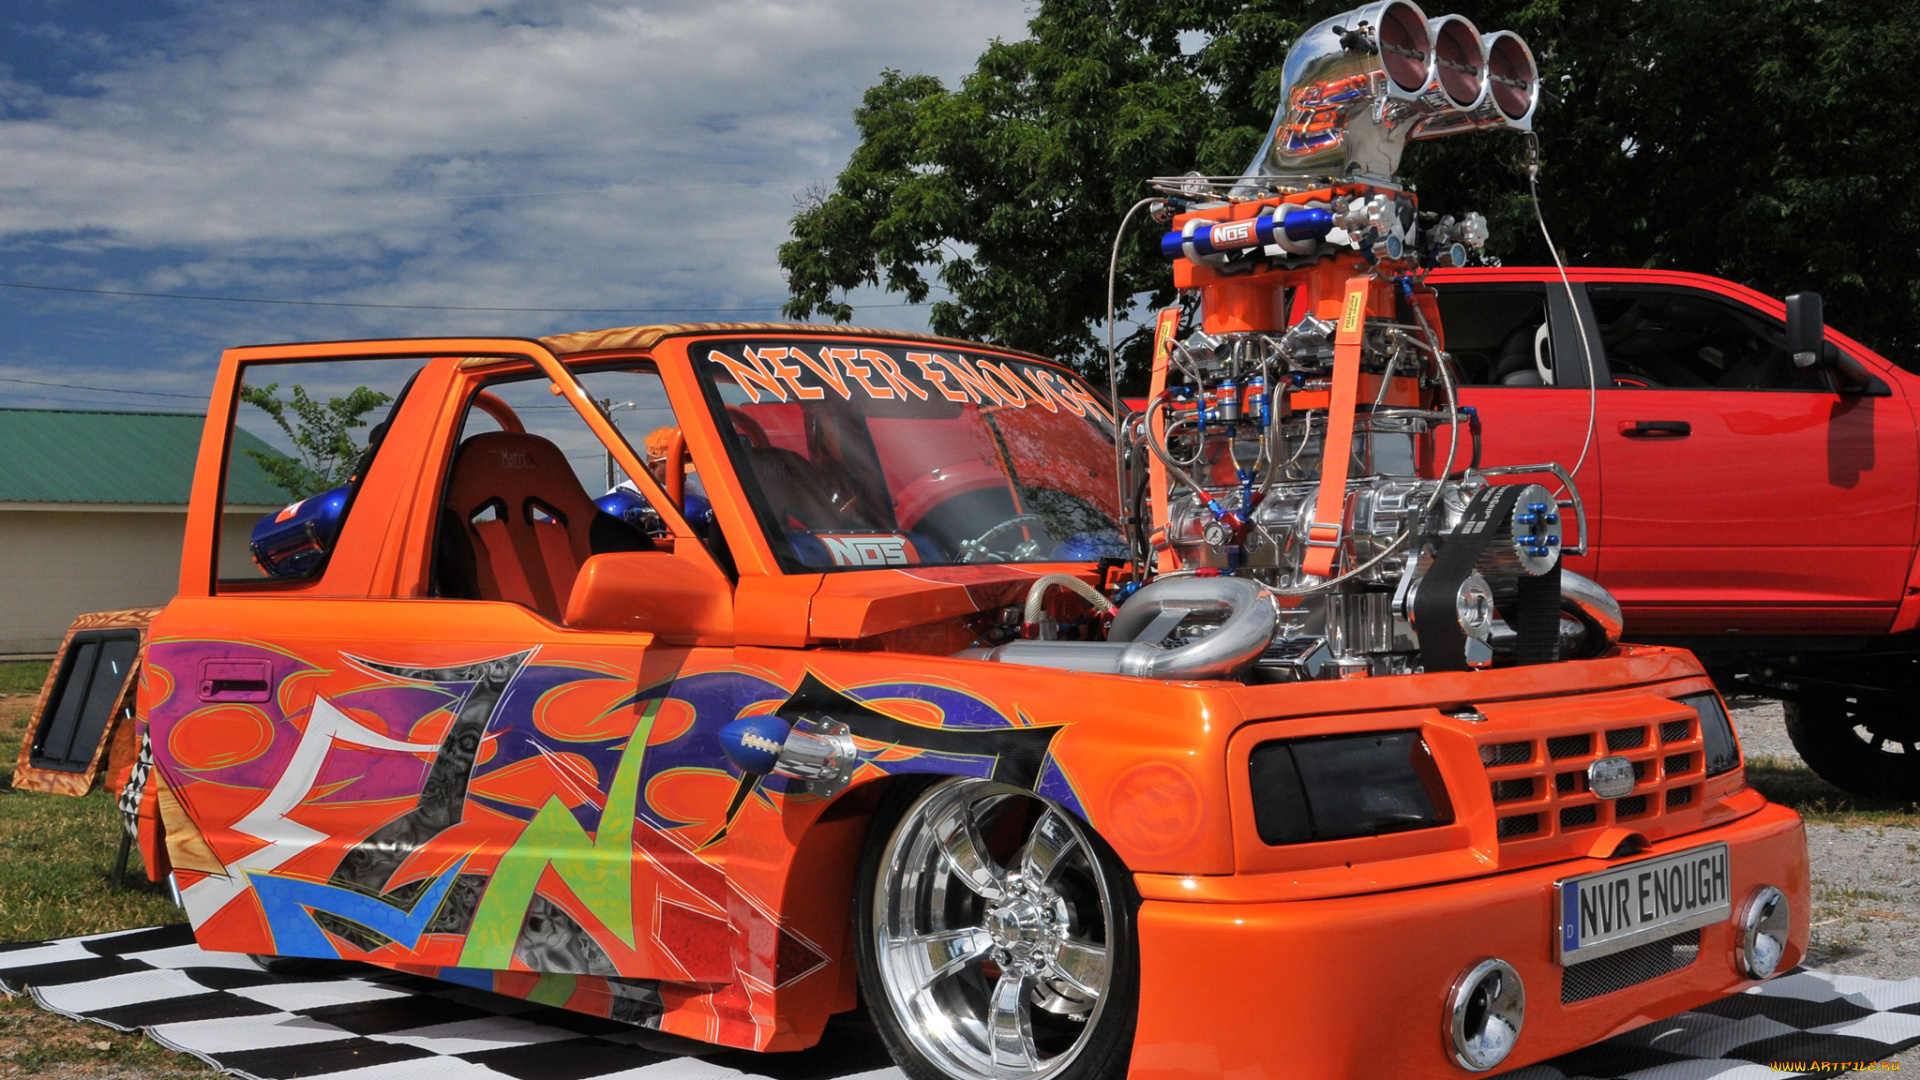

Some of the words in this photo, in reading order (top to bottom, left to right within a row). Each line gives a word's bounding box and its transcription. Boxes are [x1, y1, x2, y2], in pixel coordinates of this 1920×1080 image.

[1214, 221, 1253, 243] NOS
[708, 345, 928, 404] NEVER
[906, 353, 1116, 424] ENOUGH
[821, 534, 908, 566] NOS
[1580, 877, 1632, 939] NVR
[1637, 853, 1726, 923] ENOUGH
[1566, 924, 1574, 939] D
